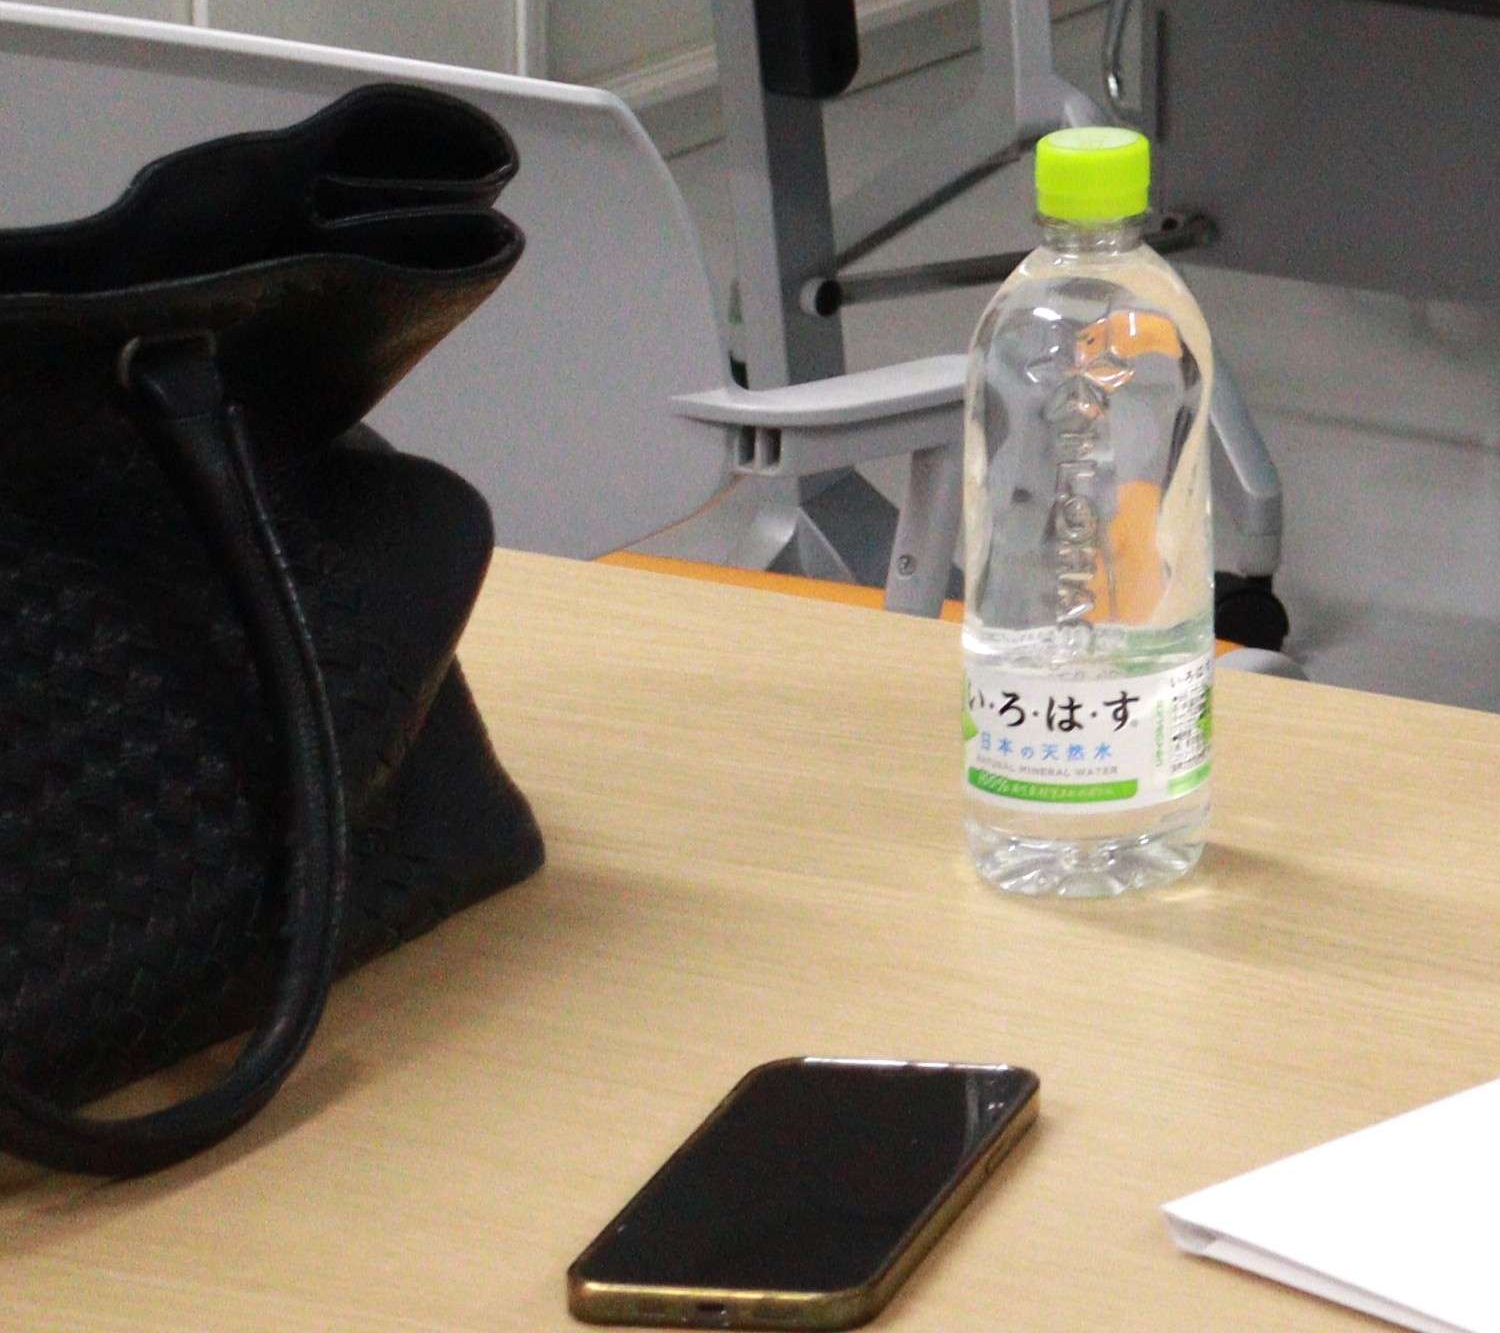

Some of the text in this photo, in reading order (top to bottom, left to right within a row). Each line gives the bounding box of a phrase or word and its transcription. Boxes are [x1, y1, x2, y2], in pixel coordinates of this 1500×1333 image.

[980, 732, 1113, 761] 日本の天然水
